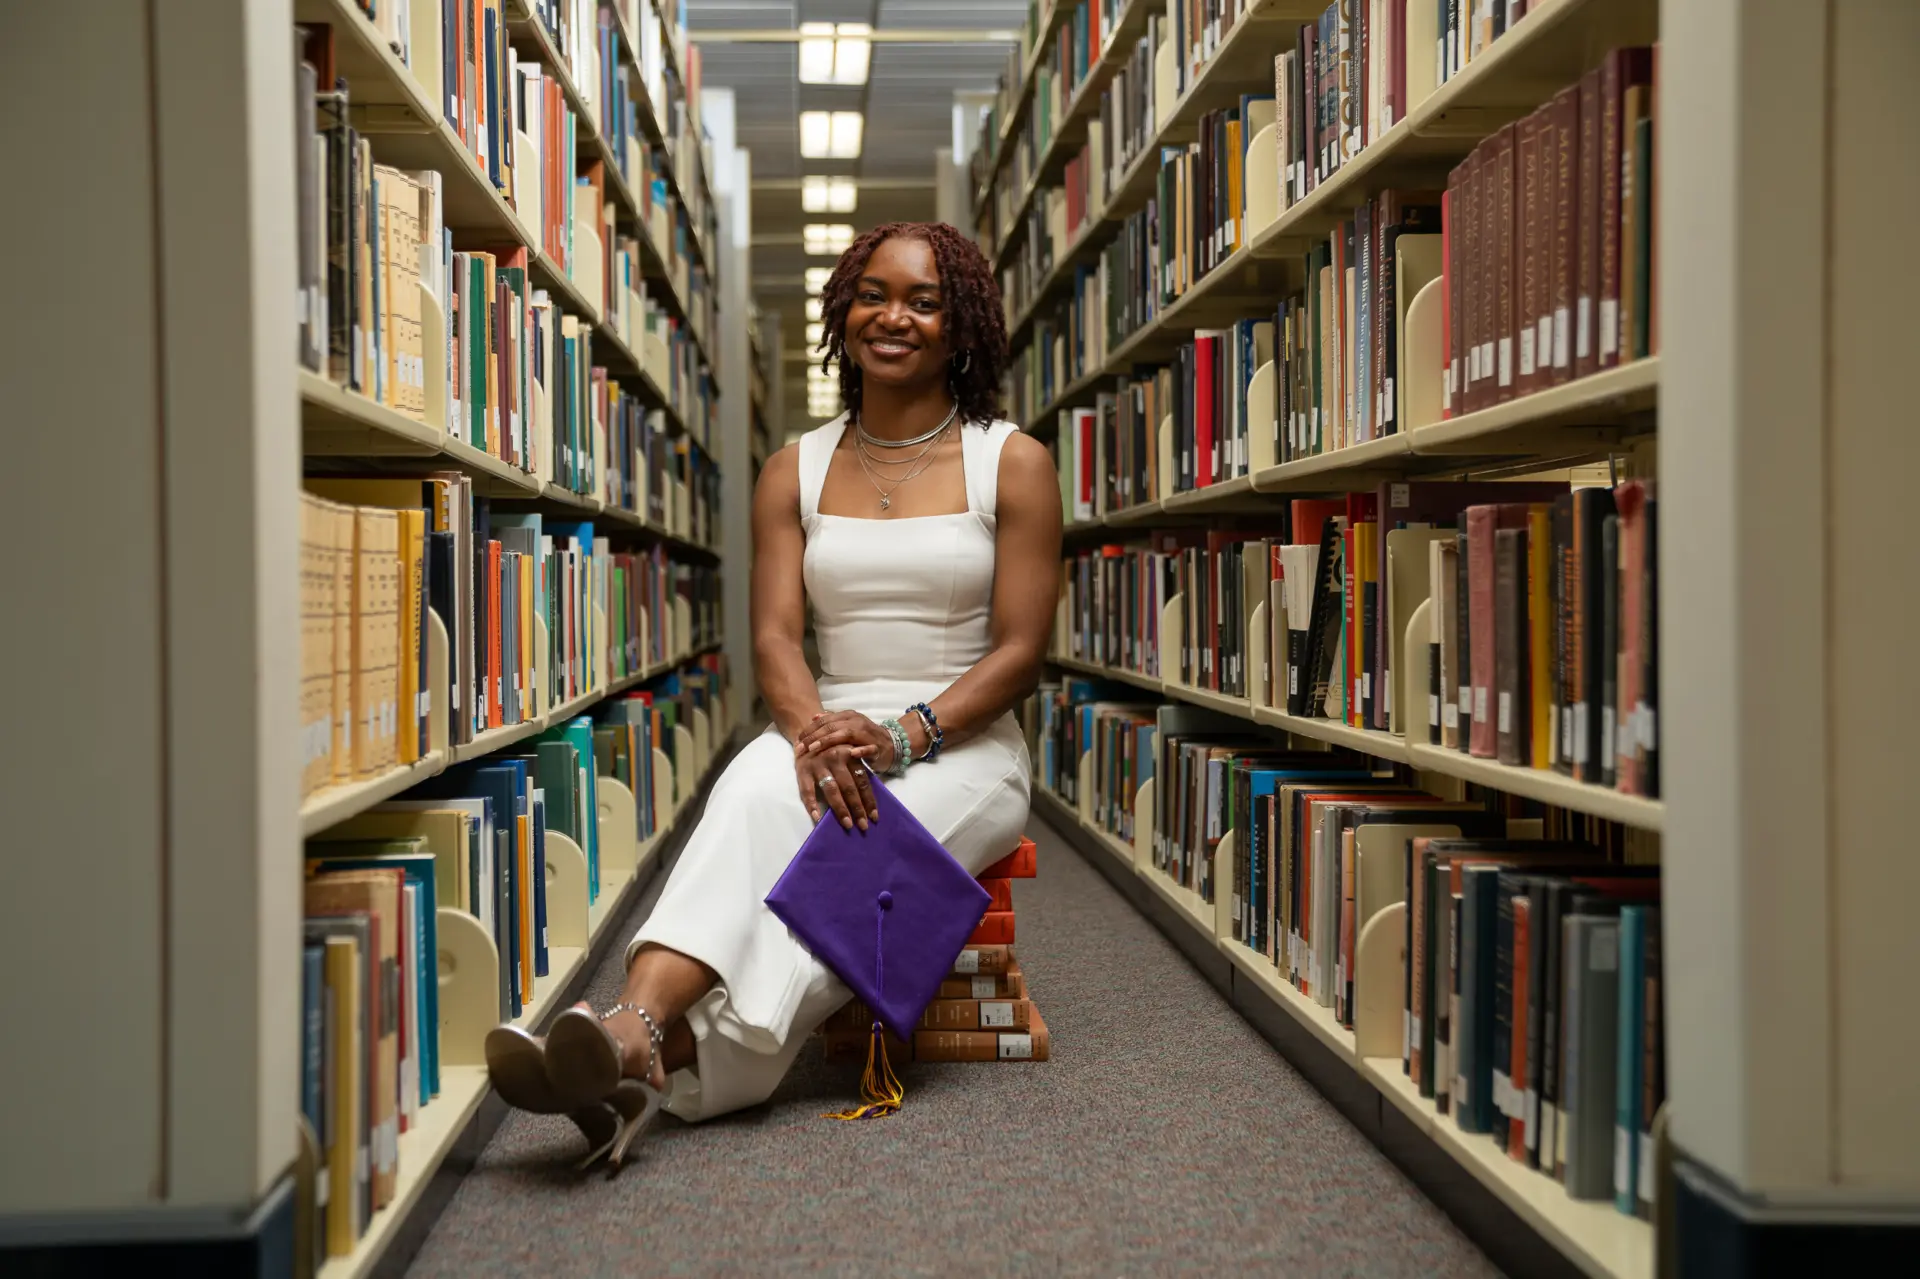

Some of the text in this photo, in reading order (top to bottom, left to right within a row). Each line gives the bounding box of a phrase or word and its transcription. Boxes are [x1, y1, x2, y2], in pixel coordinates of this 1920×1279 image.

[1502, 166, 1511, 258] MARCUS
[1526, 154, 1537, 248] MARCUS
[1559, 128, 1569, 231] MARCUS
[1361, 278, 1369, 312] Black
